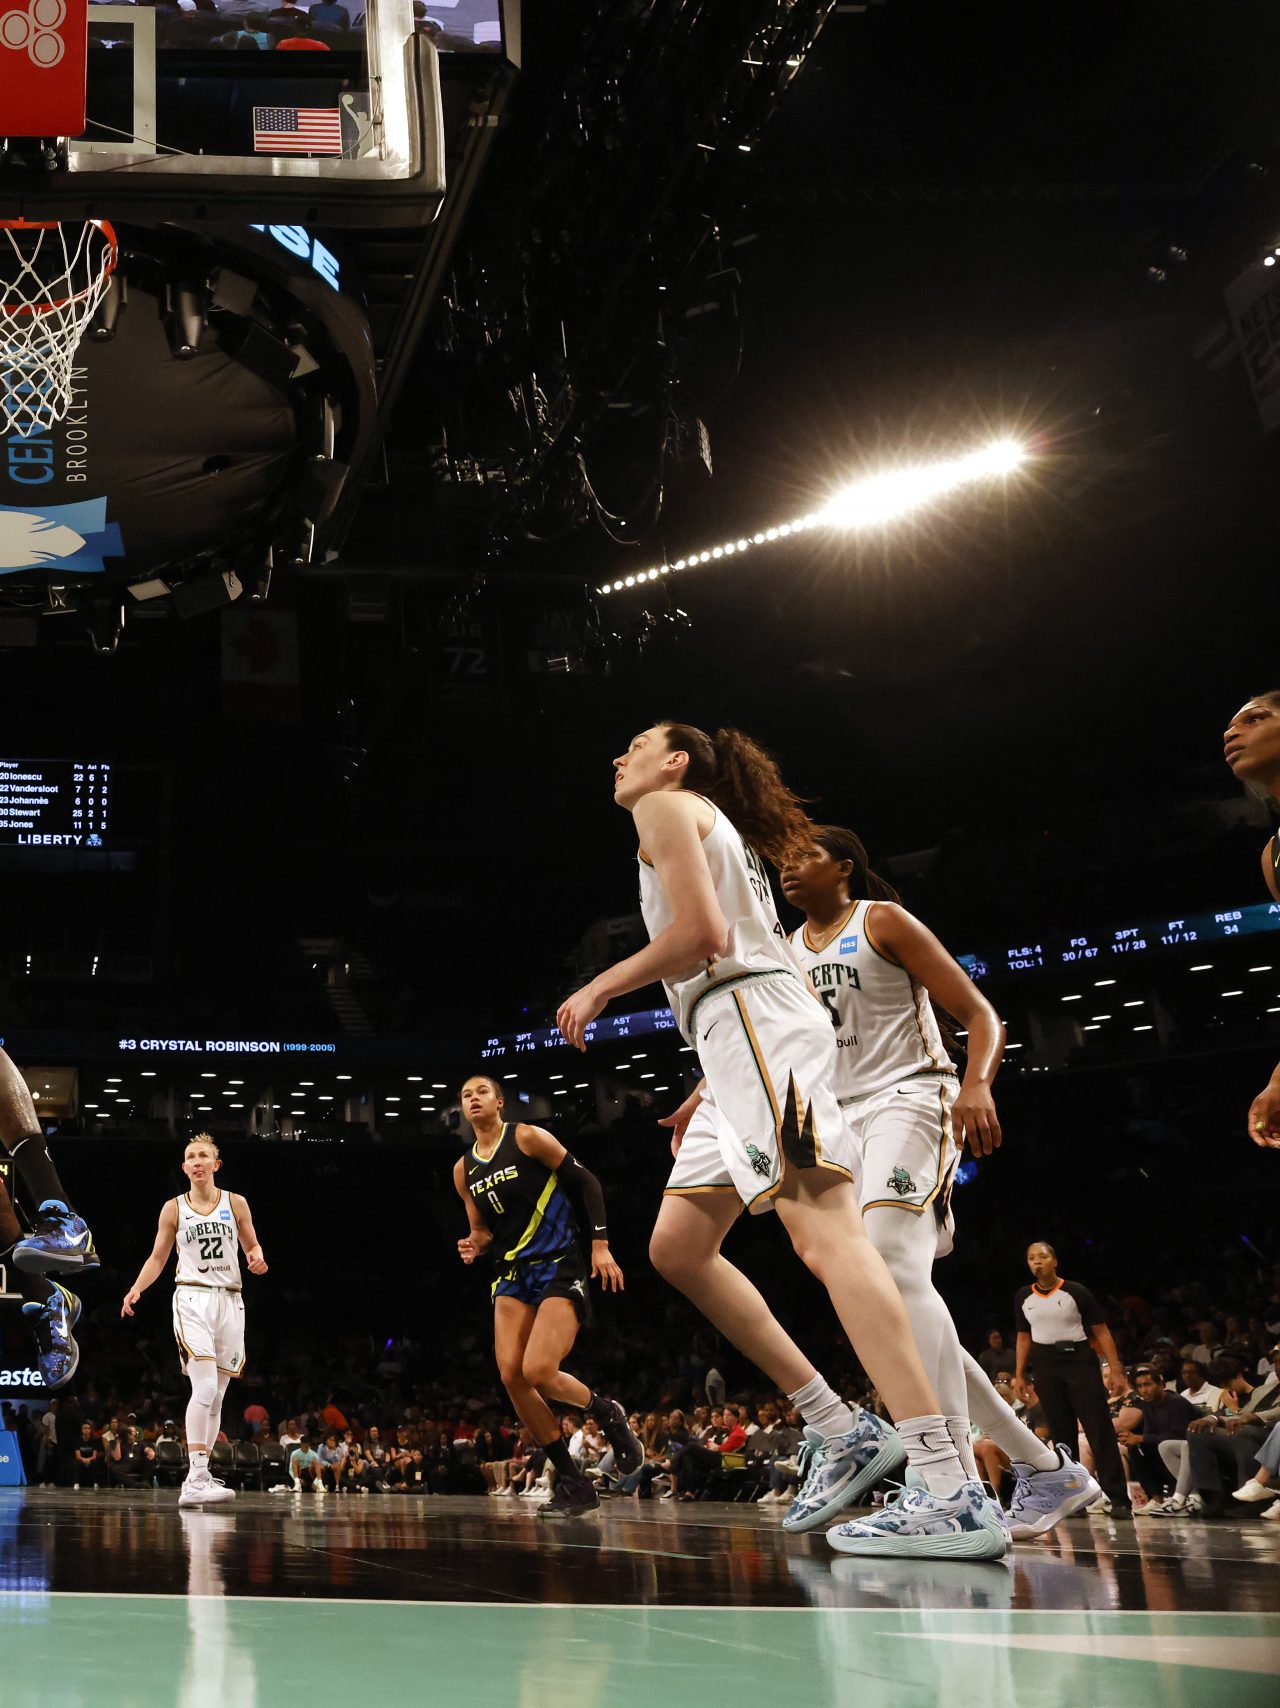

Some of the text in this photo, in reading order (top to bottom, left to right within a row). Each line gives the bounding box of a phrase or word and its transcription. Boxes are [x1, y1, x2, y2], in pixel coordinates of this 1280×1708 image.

[66, 367, 89, 482] BROOKLYN
[444, 647, 487, 674] 72
[10, 773, 43, 781] Ionescu
[9, 785, 59, 793] Vandersloot
[101, 786, 108, 794] 2
[9, 796, 49, 805] Johannès
[101, 798, 108, 806] 0
[9, 809, 41, 817] Stewart
[102, 810, 107, 818] 1
[9, 821, 34, 829] Jones
[101, 822, 107, 830] 5
[18, 834, 82, 845] LIBERTY
[1008, 947, 1033, 959] FLS:
[1034, 944, 1042, 954] 4
[1070, 937, 1087, 948] FG
[1115, 928, 1139, 941] 3PT
[1168, 920, 1185, 931] FT
[1215, 911, 1242, 923] REB
[1008, 959, 1034, 970] TOL:
[1038, 957, 1043, 966] 1
[1224, 924, 1239, 935] 34
[488, 1038, 499, 1047] FG
[516, 1033, 532, 1042] 3PT
[550, 1028, 560, 1036] FT
[585, 1021, 597, 1031] EB
[613, 1016, 630, 1026] AST
[584, 1032, 594, 1042] 39
[619, 1027, 629, 1036] 24
[119, 1039, 336, 1052] #3 CRYSTAL ROBINSON (1999-2005)
[470, 1165, 518, 1197] TEXAS
[199, 1237, 223, 1260] 22
